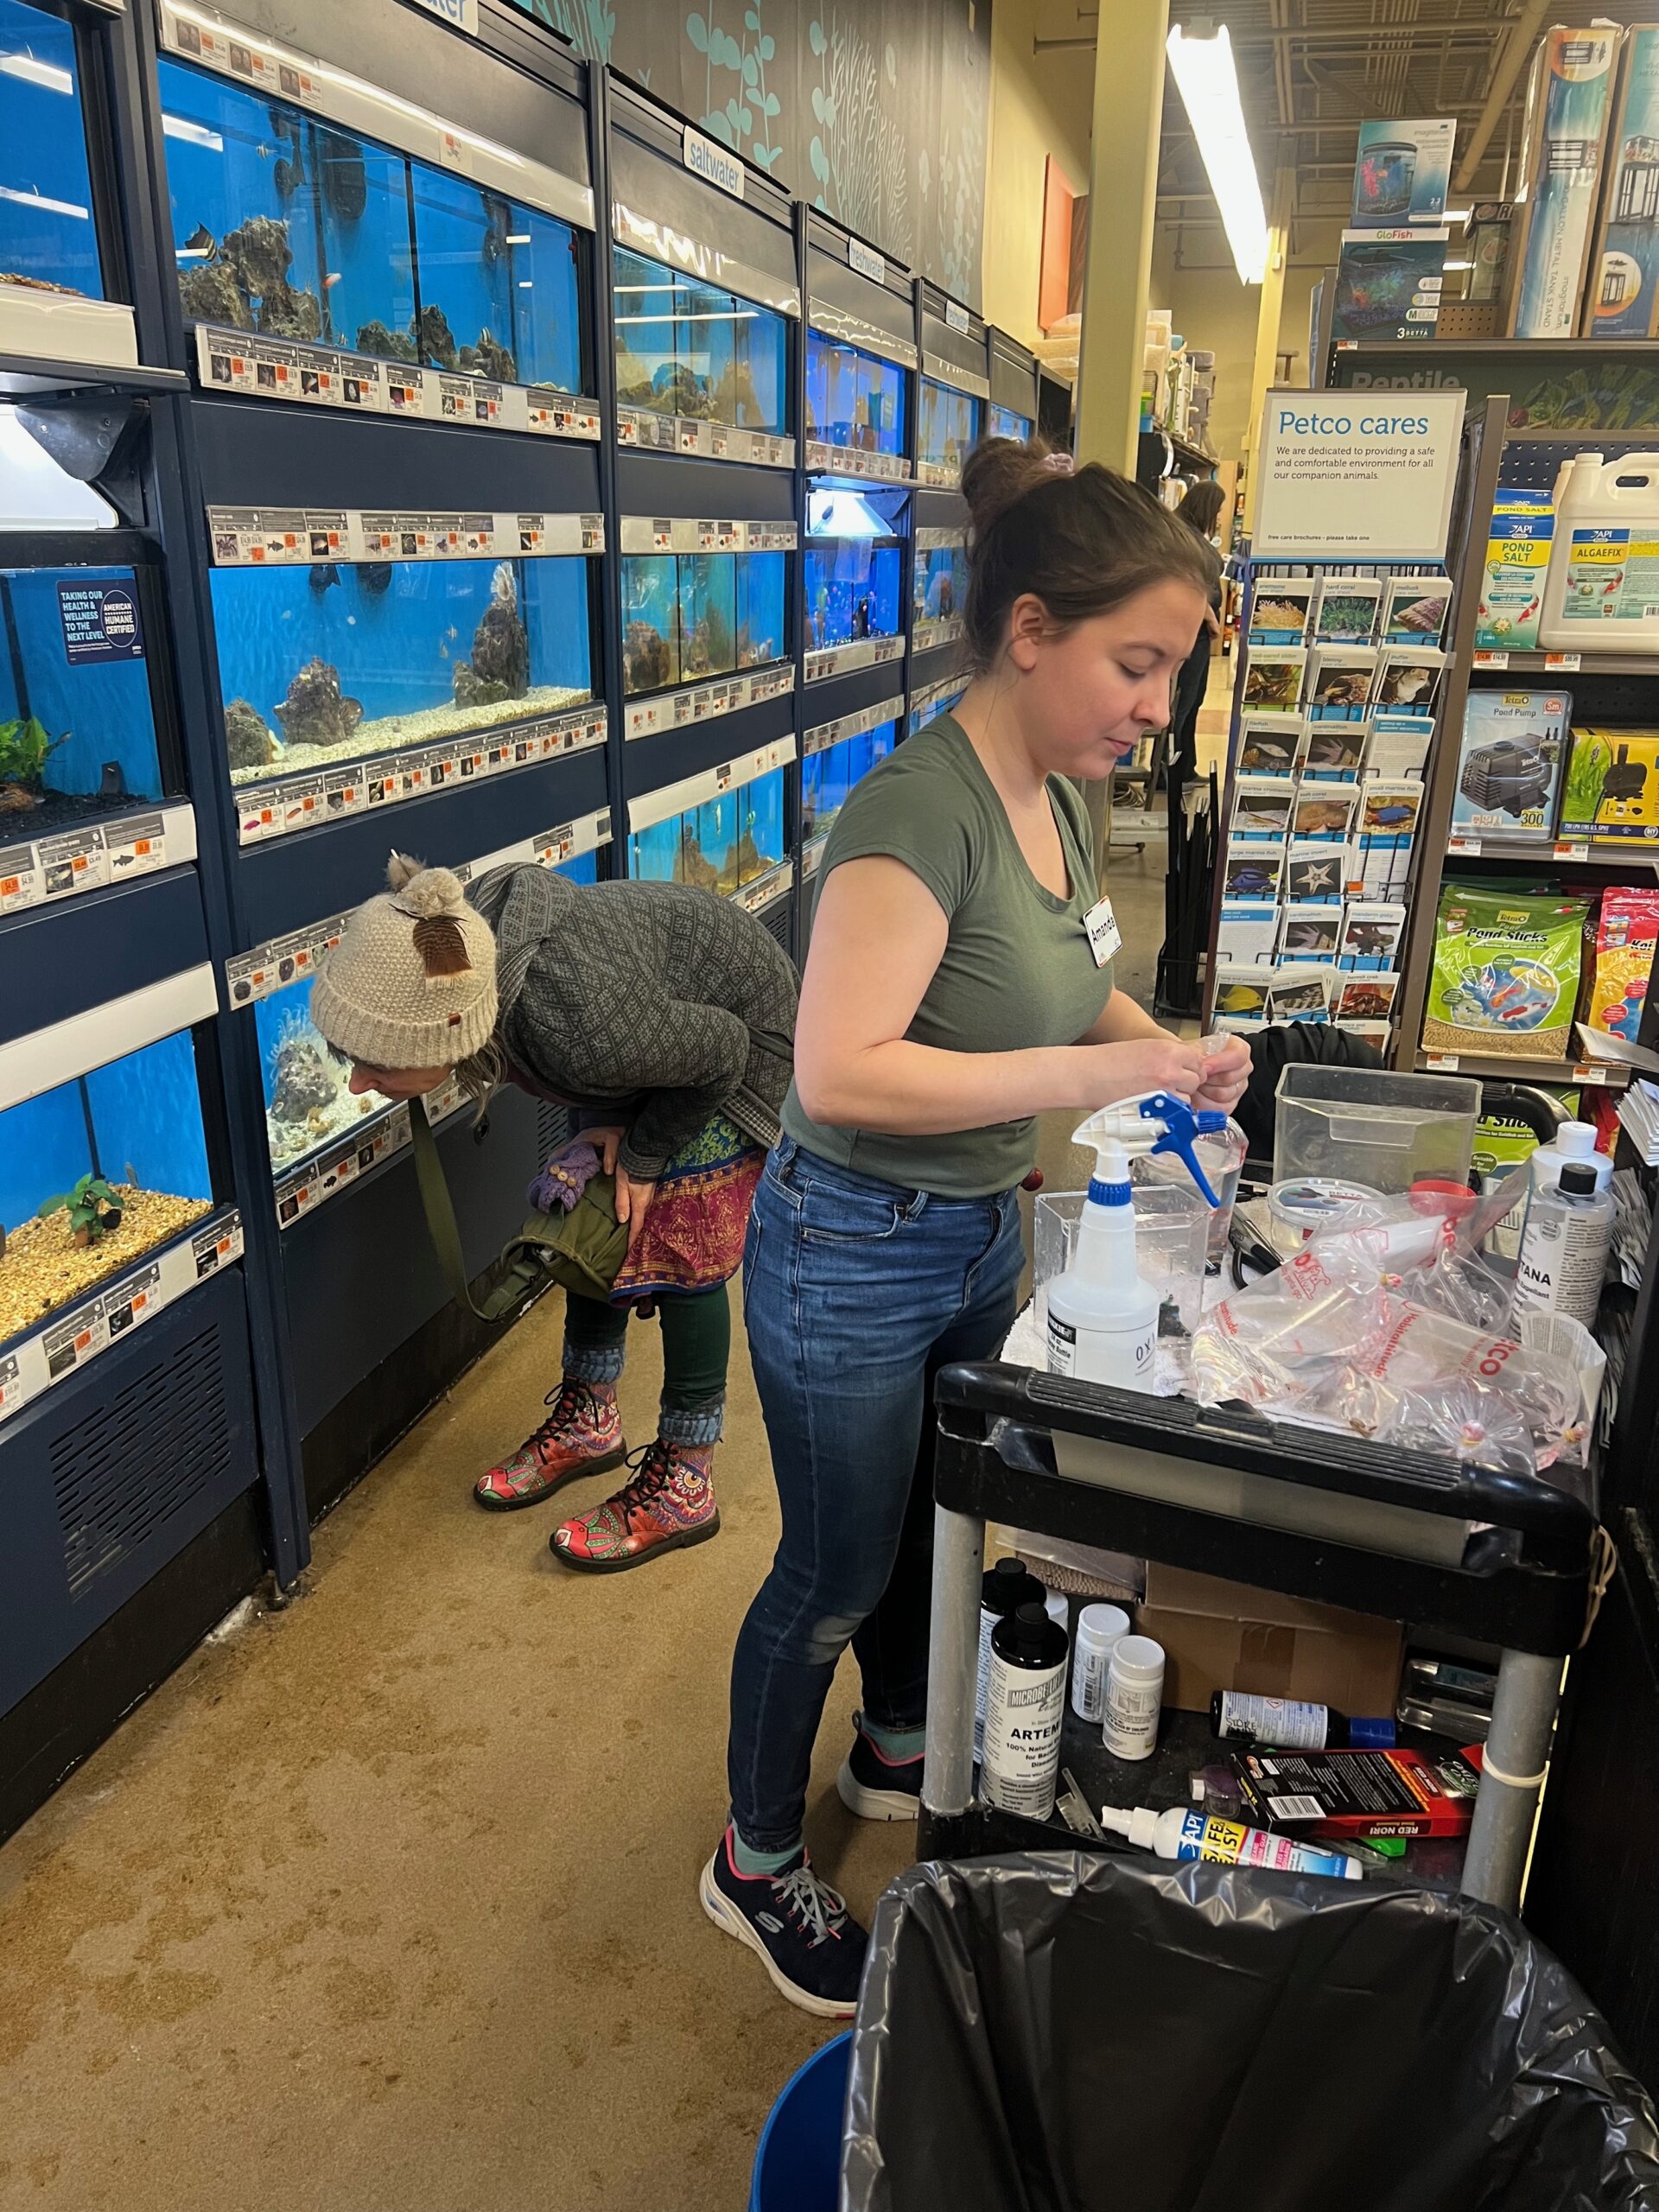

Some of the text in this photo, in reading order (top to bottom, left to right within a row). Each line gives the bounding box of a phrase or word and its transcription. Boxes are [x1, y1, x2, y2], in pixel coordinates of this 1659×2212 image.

[690, 137, 741, 192] saltwater
[1376, 230, 1413, 239] GloFish
[851, 240, 884, 279] freshwater
[1543, 296, 1554, 327] STAND
[1351, 371, 1460, 388] Reptile
[1280, 411, 1428, 435] Petco cares
[1308, 447, 1351, 455] dedicated
[1365, 447, 1408, 457] providing
[1417, 447, 1435, 455] safe
[1275, 459, 1292, 467] and
[1294, 459, 1347, 467] comfortable
[1408, 459, 1421, 467] for
[1422, 459, 1433, 467] all
[1291, 472, 1341, 481] companion
[1343, 471, 1380, 480] animals.
[1516, 524, 1533, 534] API
[1595, 530, 1612, 538] API
[1502, 543, 1535, 552] POND
[1577, 548, 1622, 557] ALGAEFIX
[1503, 552, 1531, 563] SALT
[60, 591, 103, 601] TAKING OUR
[62, 602, 90, 611] HEALTH
[104, 603, 132, 612] AMERICAN
[64, 612, 99, 621] WELLNESS
[105, 614, 133, 625] HUMANE
[65, 621, 91, 631] TO THE
[106, 625, 135, 635] CERTIFIED
[67, 631, 105, 642] NEXT LEVEL
[1546, 702, 1560, 711] Sm
[1494, 708, 1536, 718] Pond Pump
[1521, 813, 1544, 825] 300
[1090, 914, 1116, 945] Amanda
[1466, 927, 1548, 943] Pond Sticks
[1631, 939, 1654, 951] Koi
[1225, 1716, 1256, 1731] STORE
[1010, 1721, 1060, 1740] ARTEM
[1006, 1740, 1053, 1753] 100% Natural
[1185, 1814, 1204, 1840] API
[1370, 1826, 1419, 1835] RED NORI
